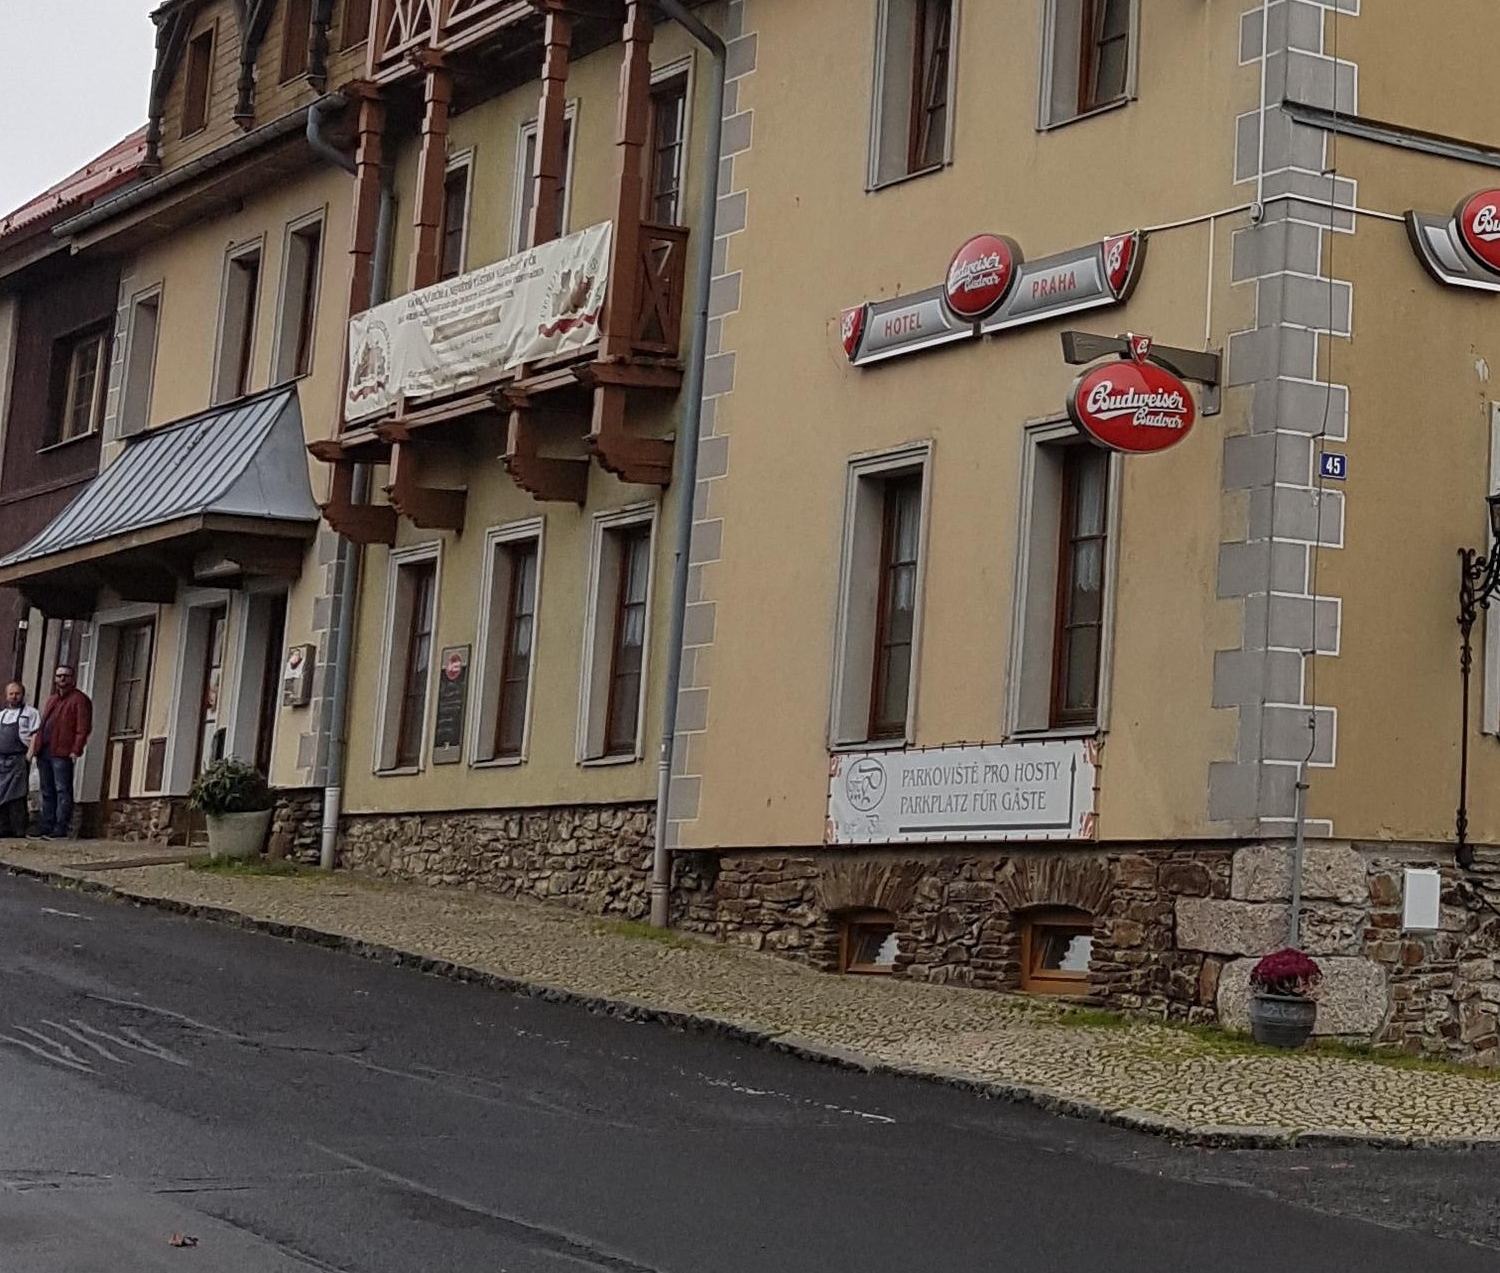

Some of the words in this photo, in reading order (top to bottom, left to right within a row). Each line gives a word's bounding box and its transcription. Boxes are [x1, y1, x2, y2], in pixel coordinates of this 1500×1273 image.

[885, 312, 922, 338] HOTEL
[1032, 270, 1077, 299] PRAHA
[1086, 380, 1184, 413] Budweiser
[1132, 407, 1184, 429] Budvar
[1326, 456, 1341, 474] 45
[902, 760, 978, 787] PARKOVIŠTĚ
[983, 763, 1009, 784] PRO
[1015, 761, 1061, 782] HOSTY
[900, 794, 968, 815] PARKPLATZ
[973, 788, 997, 812] FÜR
[1002, 787, 1046, 812] GÄSTE
